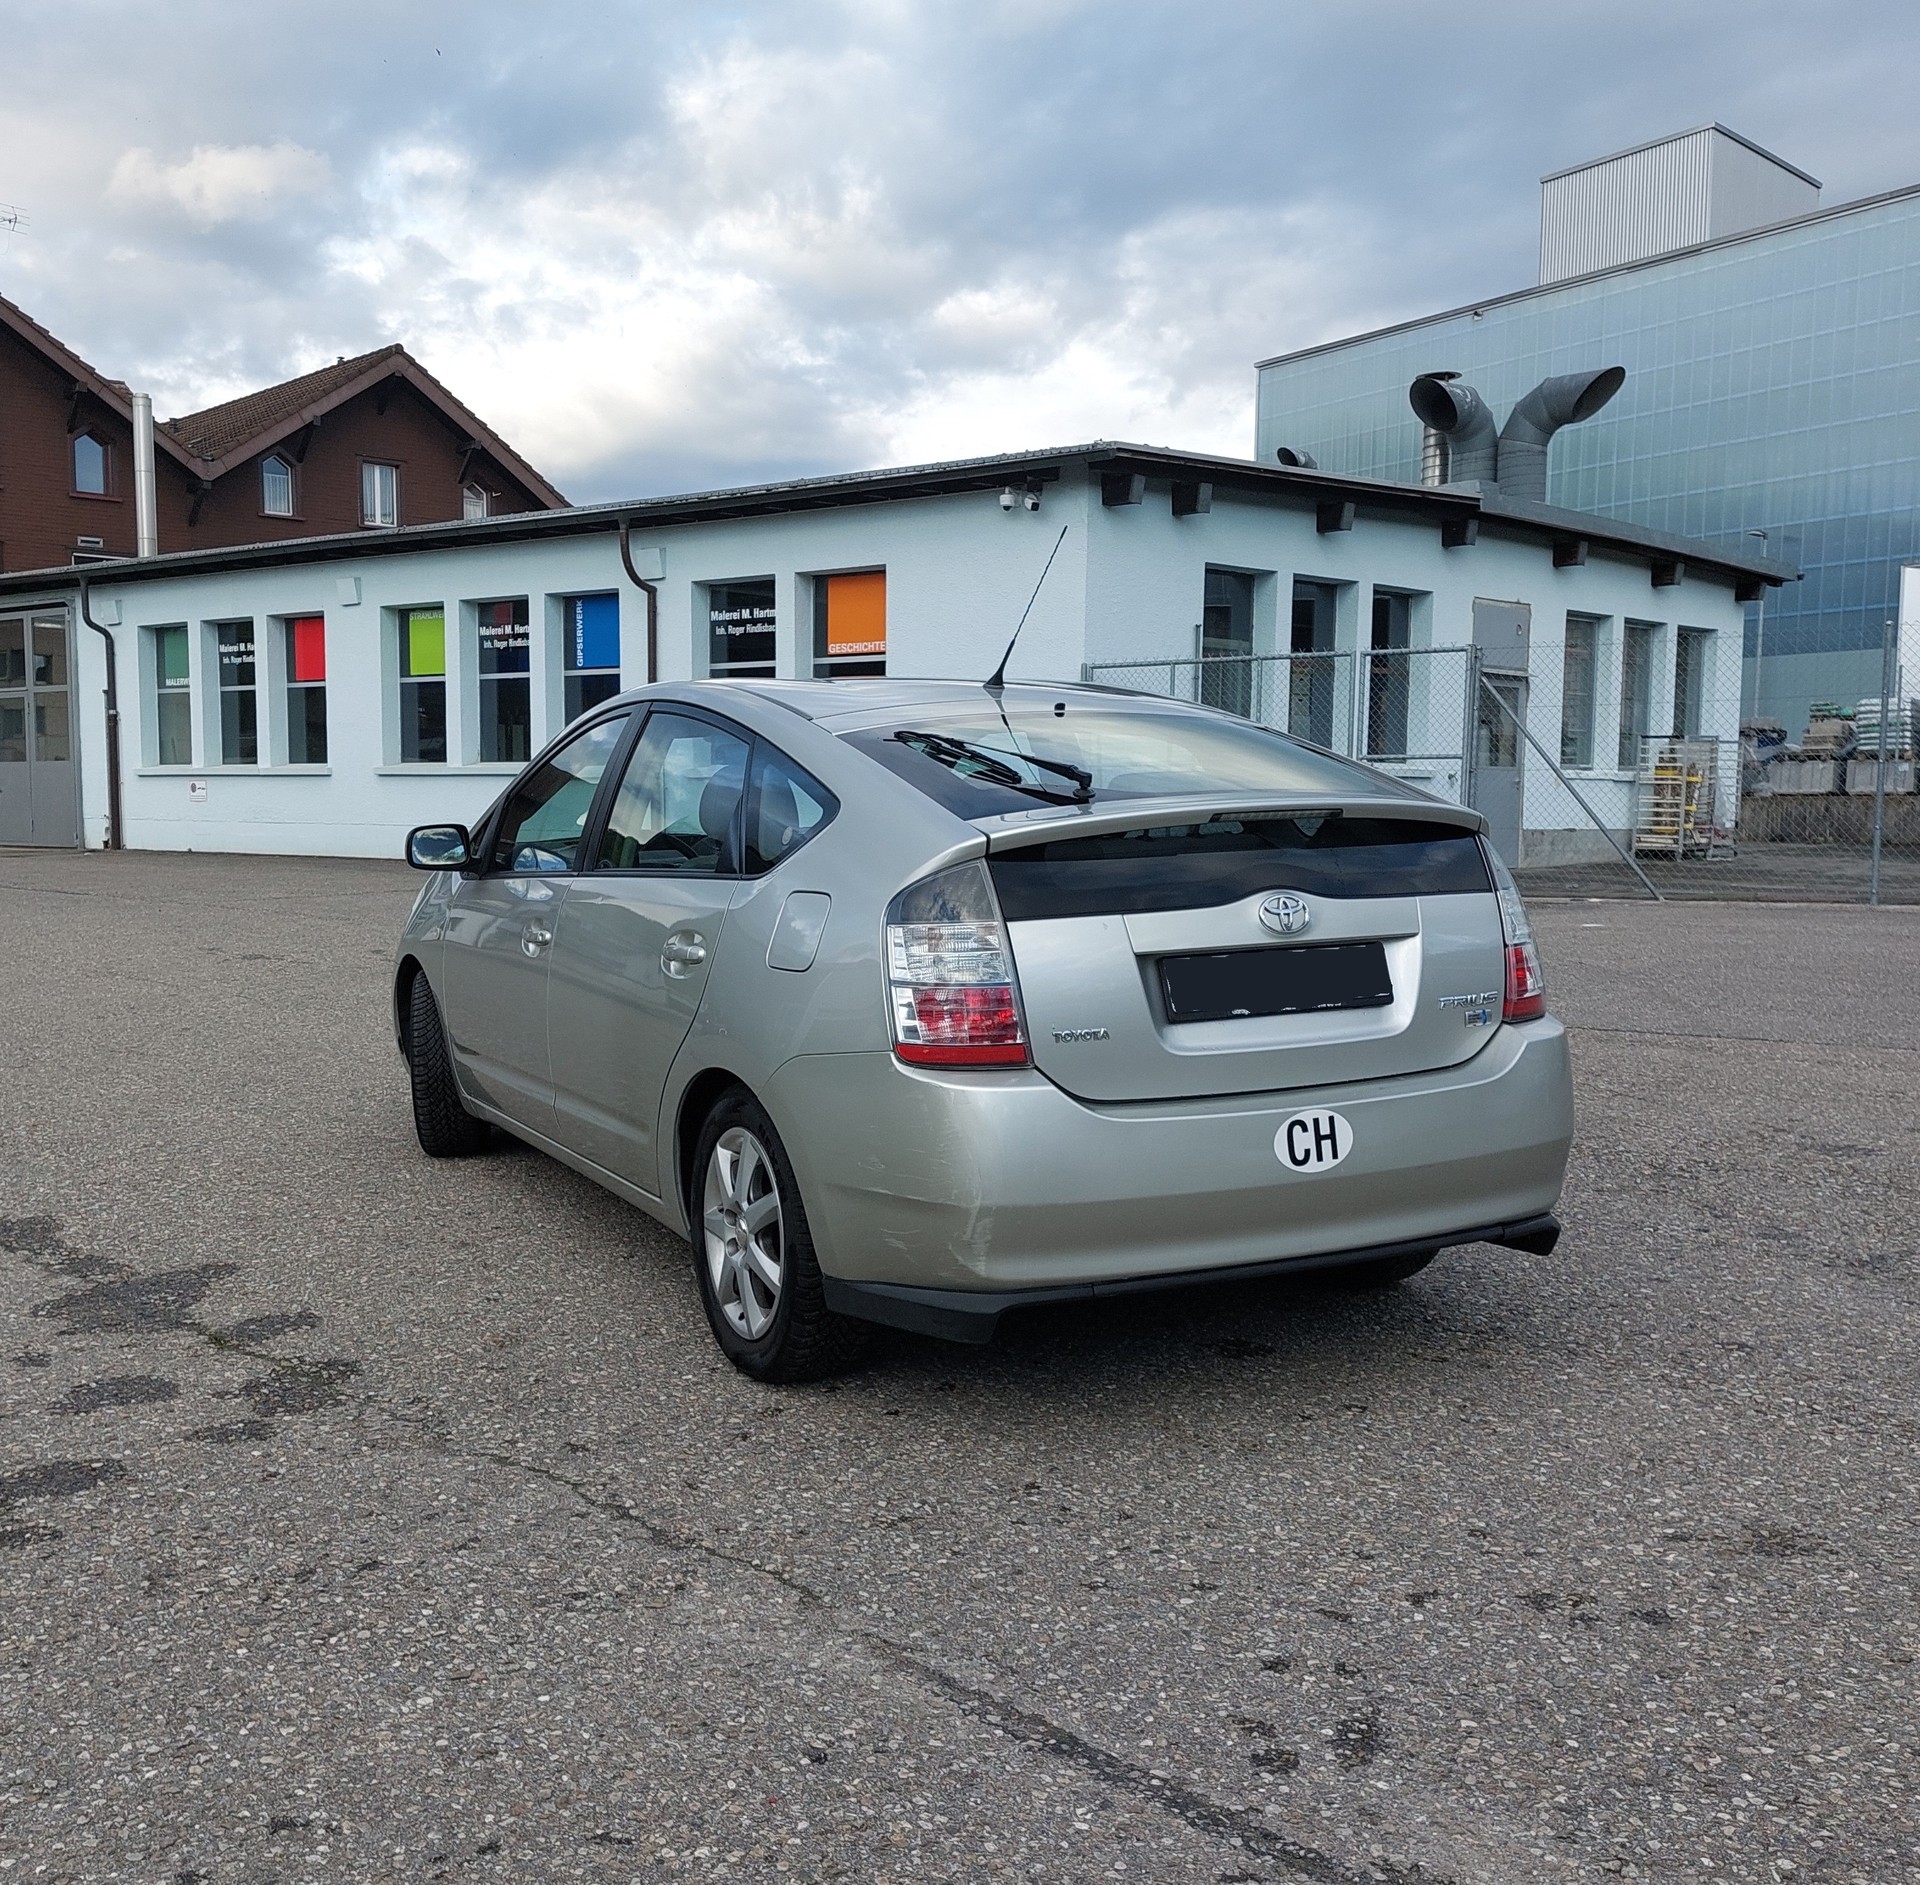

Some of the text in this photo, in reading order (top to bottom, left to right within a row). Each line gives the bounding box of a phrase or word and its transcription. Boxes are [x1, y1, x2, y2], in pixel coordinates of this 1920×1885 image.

[711, 608, 740, 621] Malerei
[742, 608, 752, 619] M.
[480, 625, 504, 636] Malerei
[505, 624, 513, 635] M.
[576, 599, 584, 667] GIPSERWERK
[728, 624, 745, 636] Roger
[220, 643, 239, 653] Malerei
[828, 641, 886, 653] GESCHICHTE
[1439, 991, 1498, 1010] PRIUS
[1052, 1027, 1110, 1043] TOYOTA
[1287, 1115, 1339, 1167] CH
